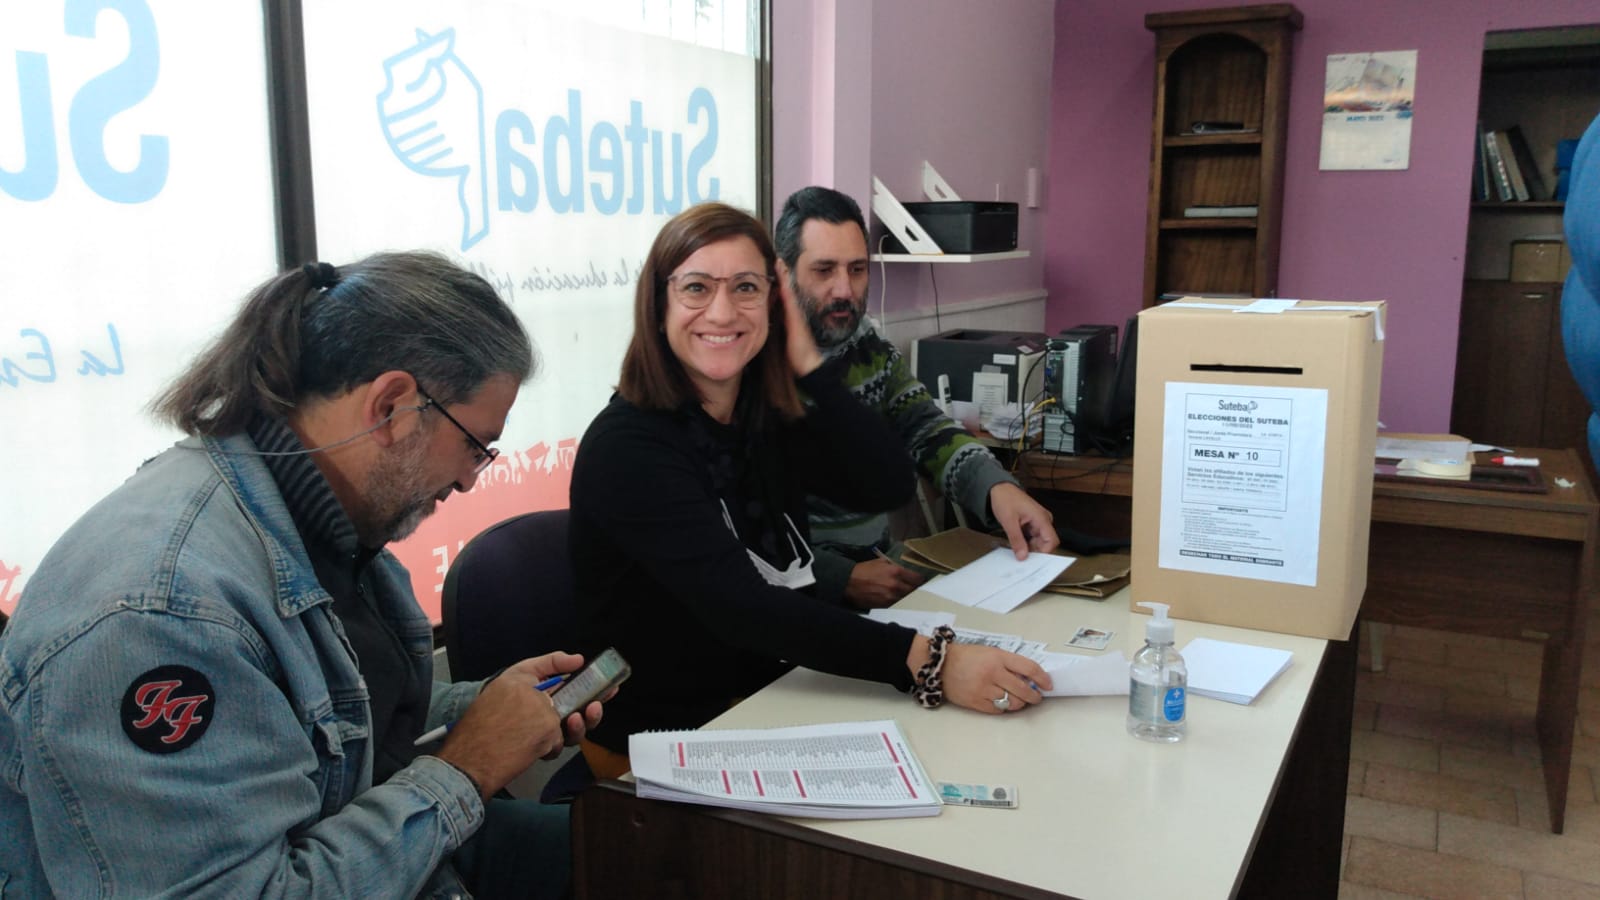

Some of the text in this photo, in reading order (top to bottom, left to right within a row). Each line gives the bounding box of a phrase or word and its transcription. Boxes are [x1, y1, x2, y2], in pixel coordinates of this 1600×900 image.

[1218, 399, 1248, 412] Suteba
[1187, 412, 1237, 423] ELECCIONES
[1239, 416, 1255, 424] DEL
[1256, 417, 1289, 426] SUTEBA
[1194, 448, 1225, 459] MESA
[1246, 451, 1259, 461] 10
